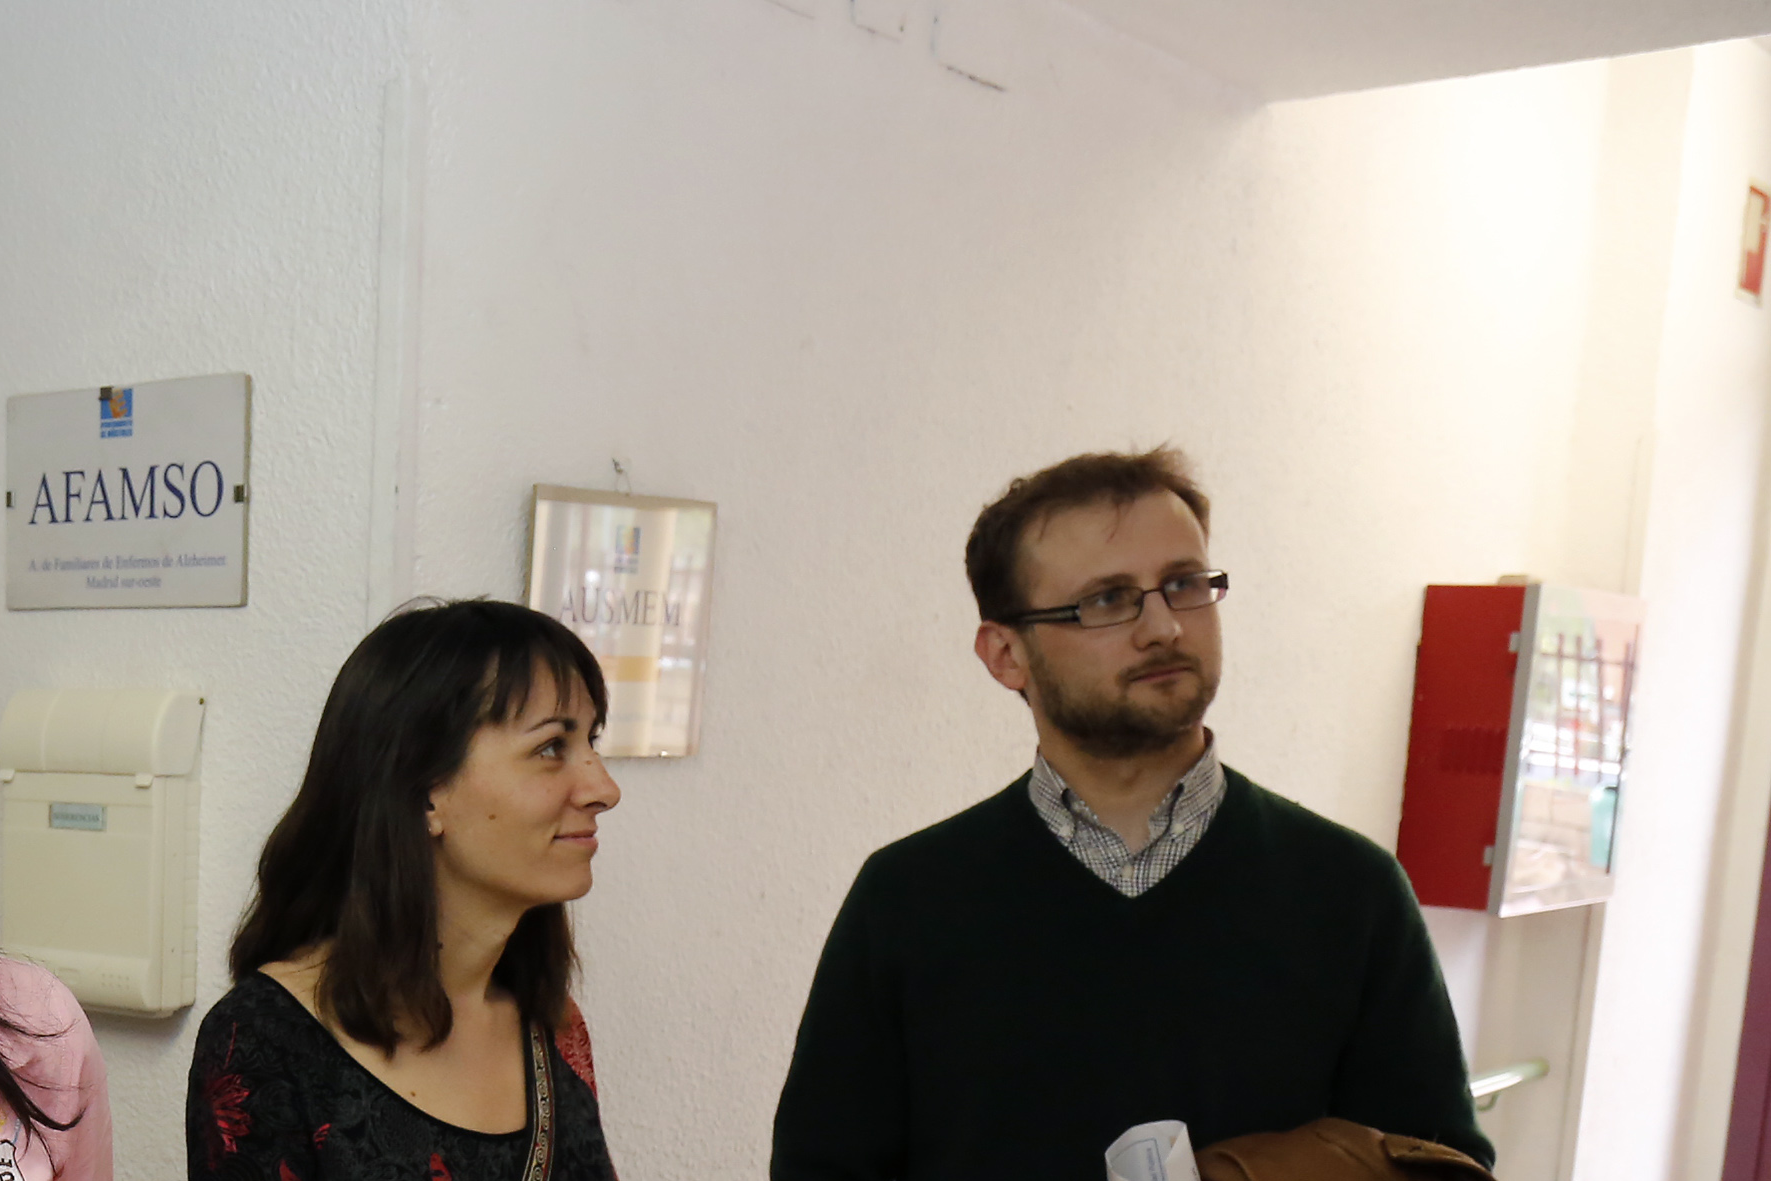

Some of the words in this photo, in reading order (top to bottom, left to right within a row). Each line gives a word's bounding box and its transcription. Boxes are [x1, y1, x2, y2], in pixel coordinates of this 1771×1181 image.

[28, 460, 224, 525] AFAMSO
[54, 557, 100, 571] Familiares
[102, 556, 113, 569] de
[116, 555, 160, 569] Enfermos
[161, 554, 174, 568] de
[85, 575, 119, 589] Madrid
[559, 585, 681, 626] AUSMEM
